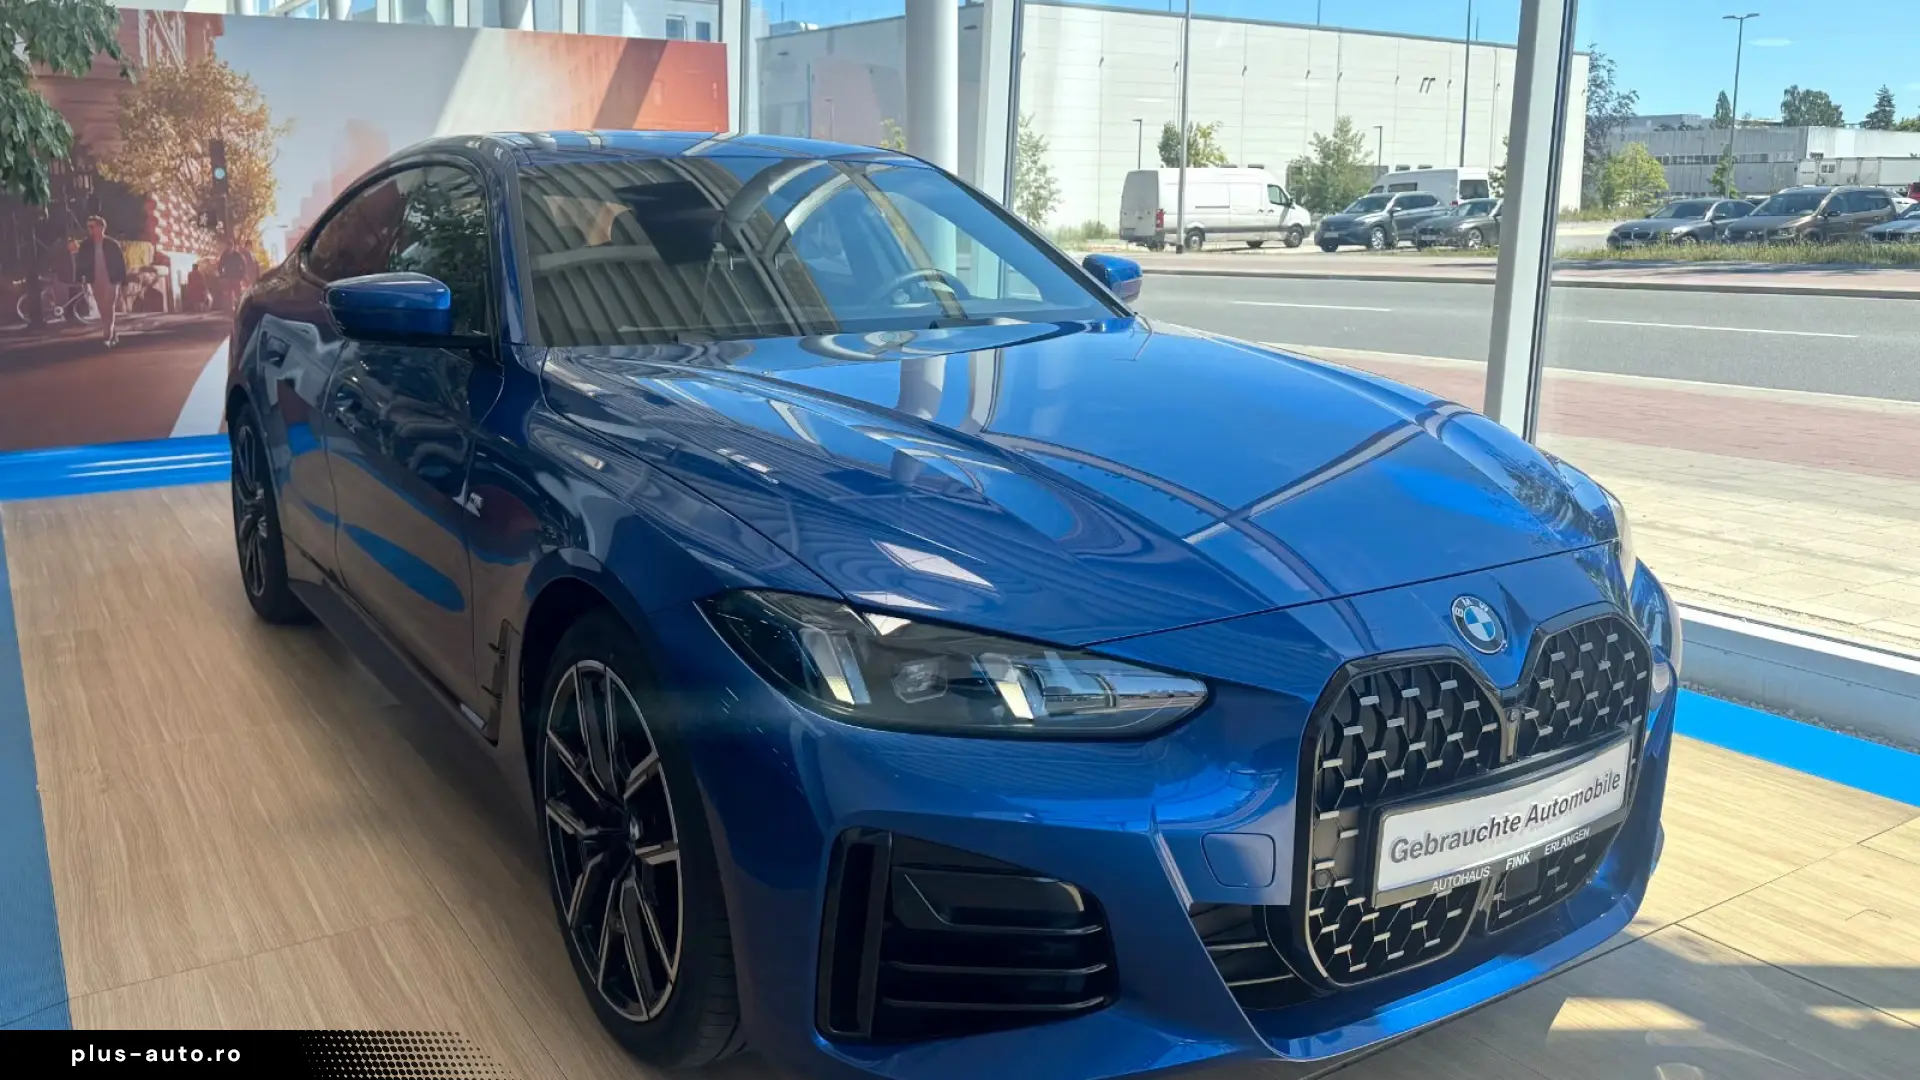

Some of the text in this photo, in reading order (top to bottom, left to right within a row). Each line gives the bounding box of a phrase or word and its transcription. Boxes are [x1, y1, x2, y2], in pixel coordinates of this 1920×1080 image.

[1390, 771, 1620, 863] Gebrauchte Automobile
[1432, 828, 1590, 892] AUTOHAUS FINK ERLANGEN
